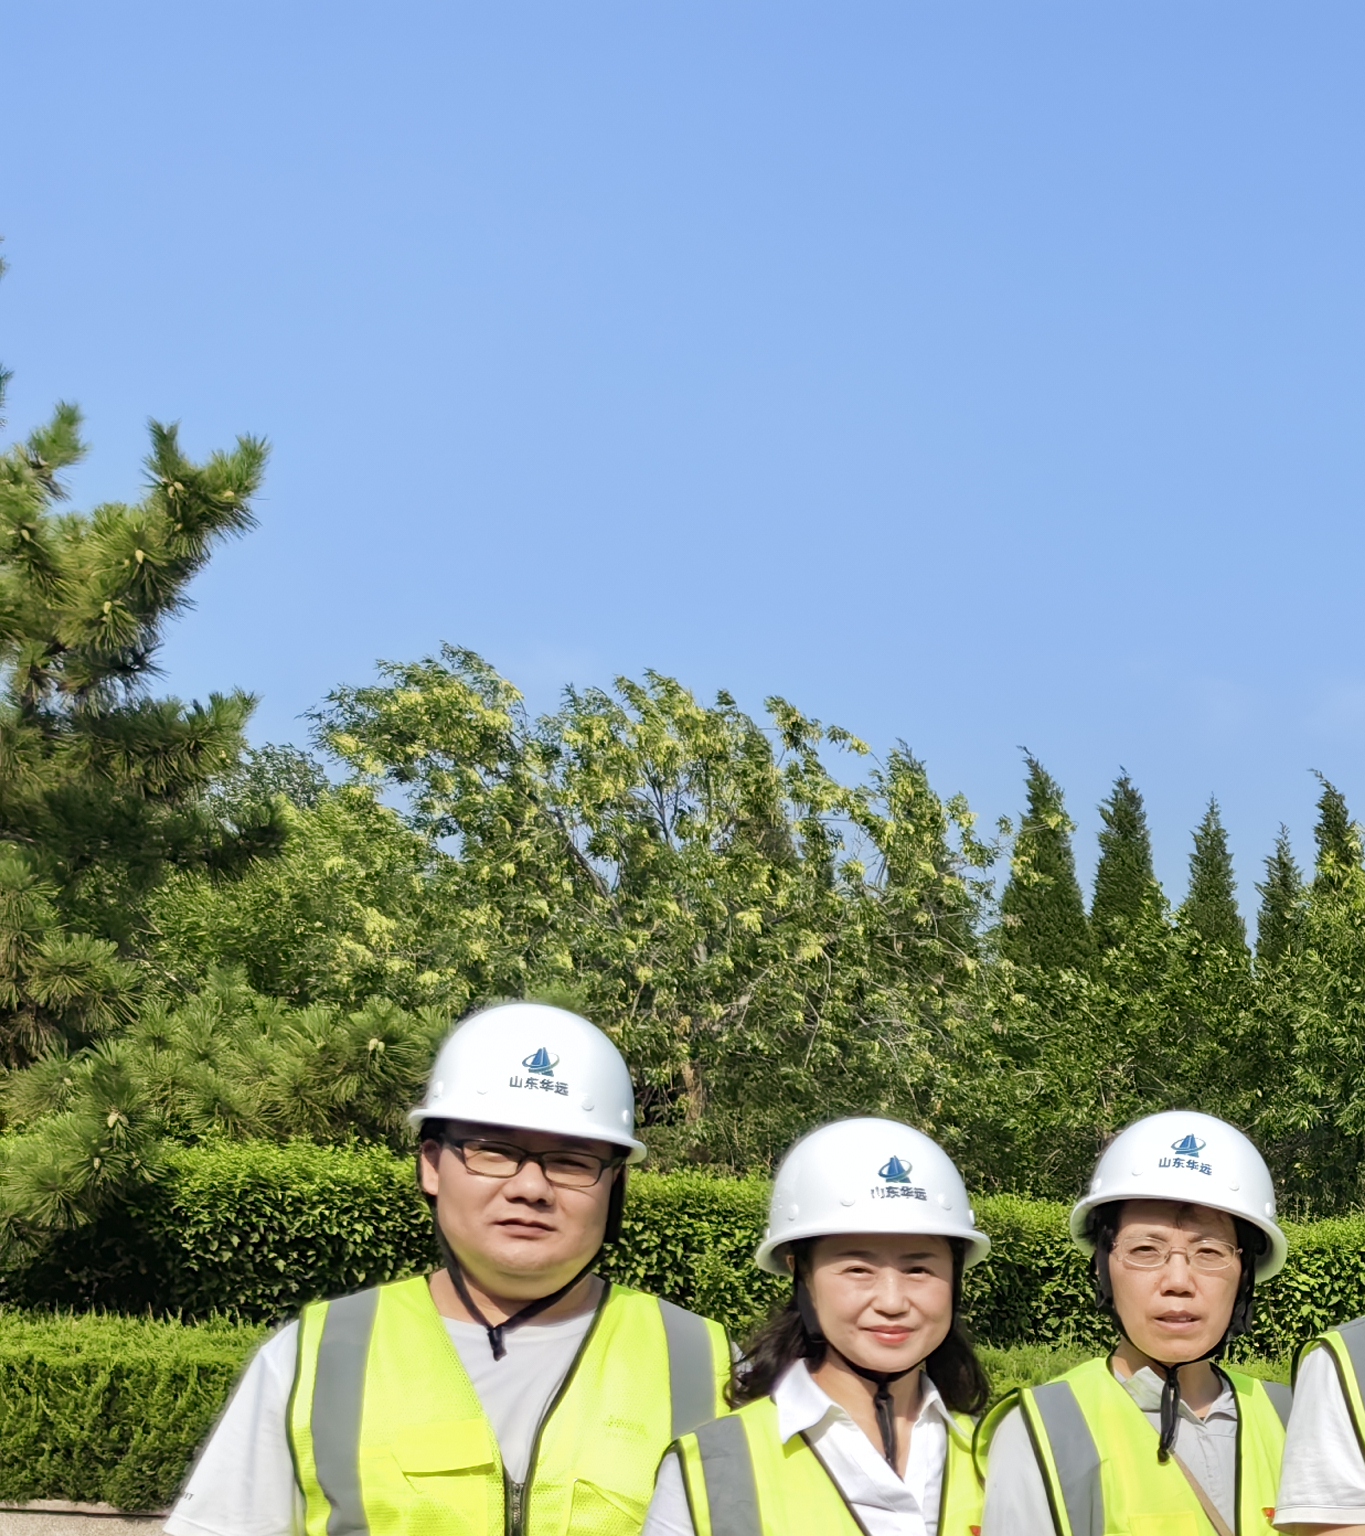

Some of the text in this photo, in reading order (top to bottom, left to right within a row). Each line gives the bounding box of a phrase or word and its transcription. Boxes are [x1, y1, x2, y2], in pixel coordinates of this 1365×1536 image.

[509, 1076, 569, 1096] 山东华远
[1158, 1157, 1212, 1176] 山东华远
[870, 1186, 927, 1202] 山东华远
